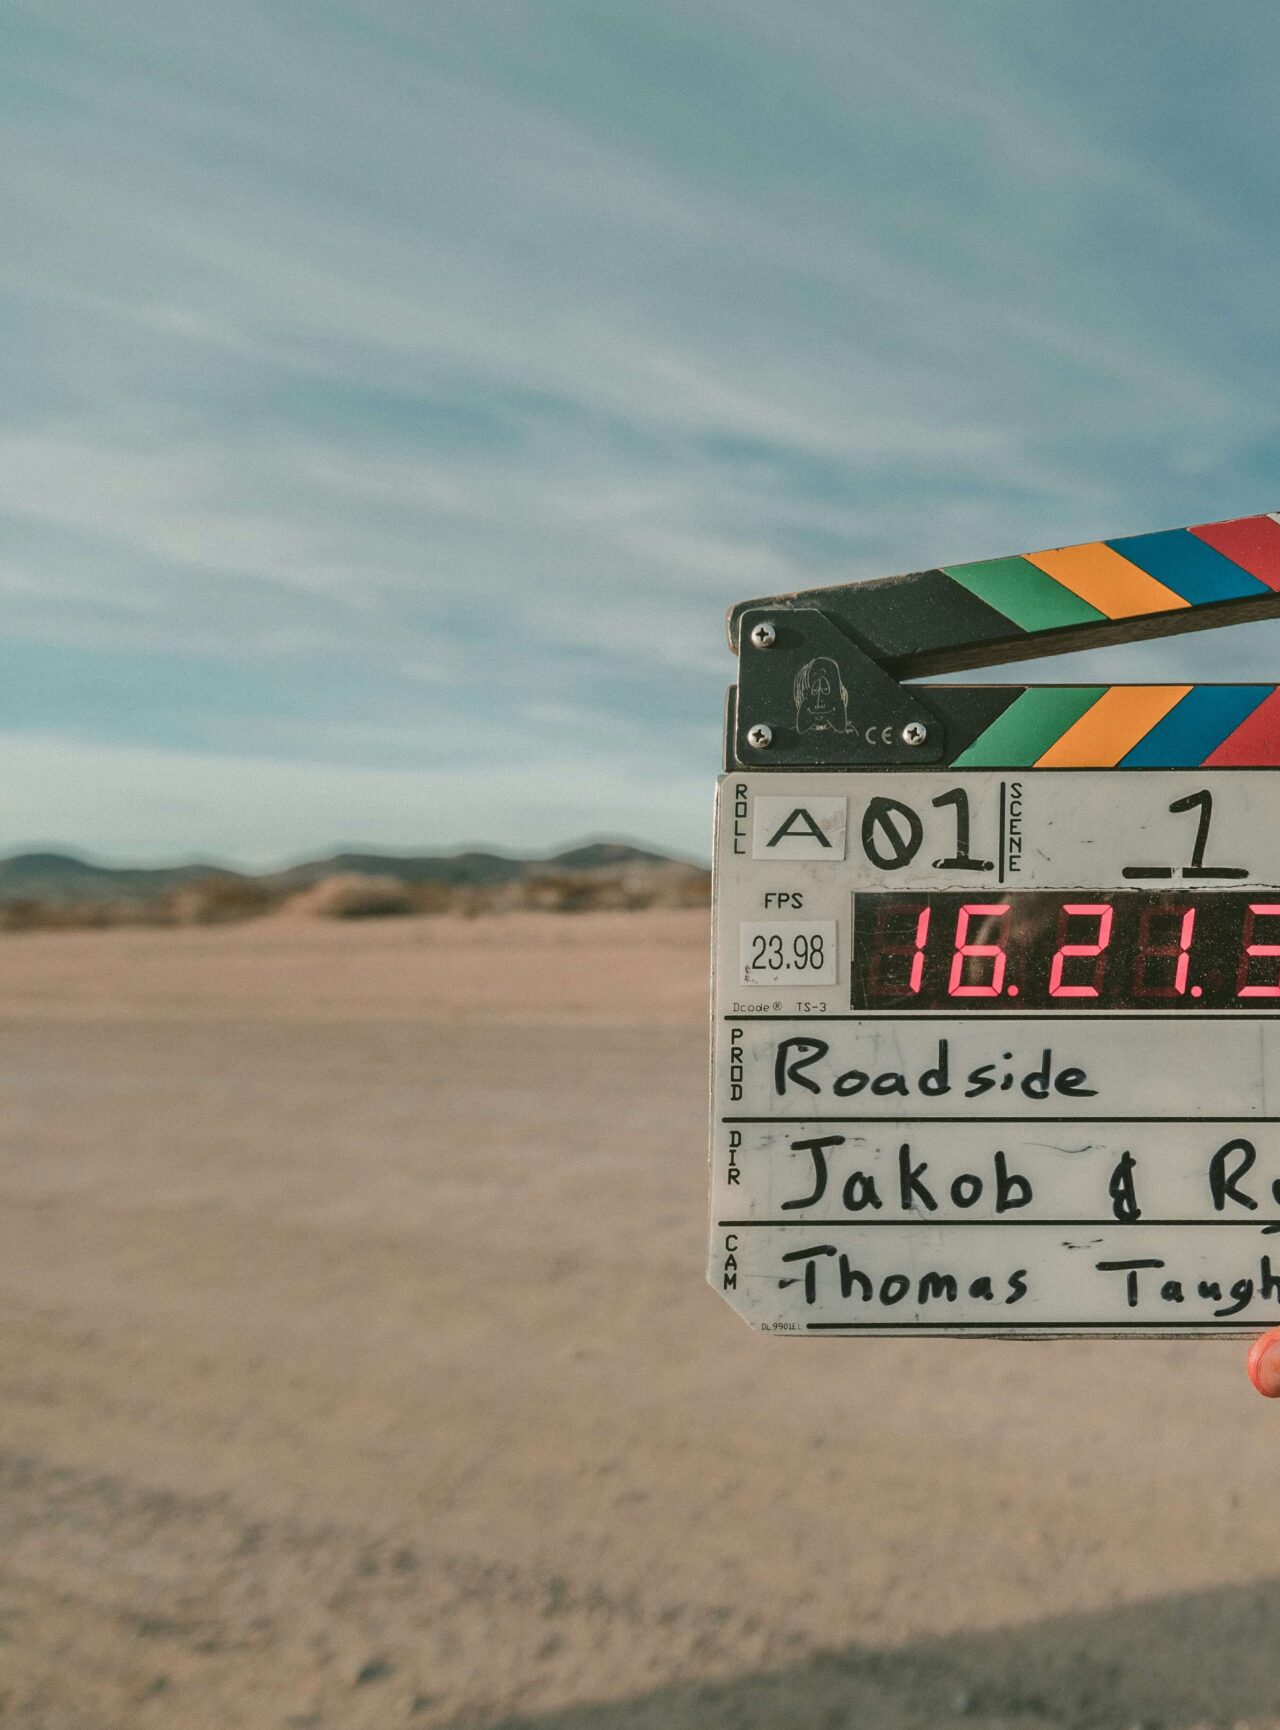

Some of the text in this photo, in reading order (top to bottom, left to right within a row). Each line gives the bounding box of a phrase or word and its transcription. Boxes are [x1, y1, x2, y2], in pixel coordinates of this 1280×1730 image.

[733, 783, 748, 855] ROLL
[765, 807, 834, 848] A
[861, 787, 995, 871] 01
[1008, 782, 1023, 872] SCENE
[764, 893, 804, 910] FPS
[751, 934, 825, 971] 23.98
[796, 1002, 828, 1013] TS-3
[730, 1028, 743, 1102] PROD
[774, 1037, 1100, 1099] Roadside
[727, 1130, 742, 1186] DIR
[780, 1135, 1034, 1214] Jakob
[723, 1234, 739, 1290] CAM
[778, 1244, 1028, 1305] Thomas
